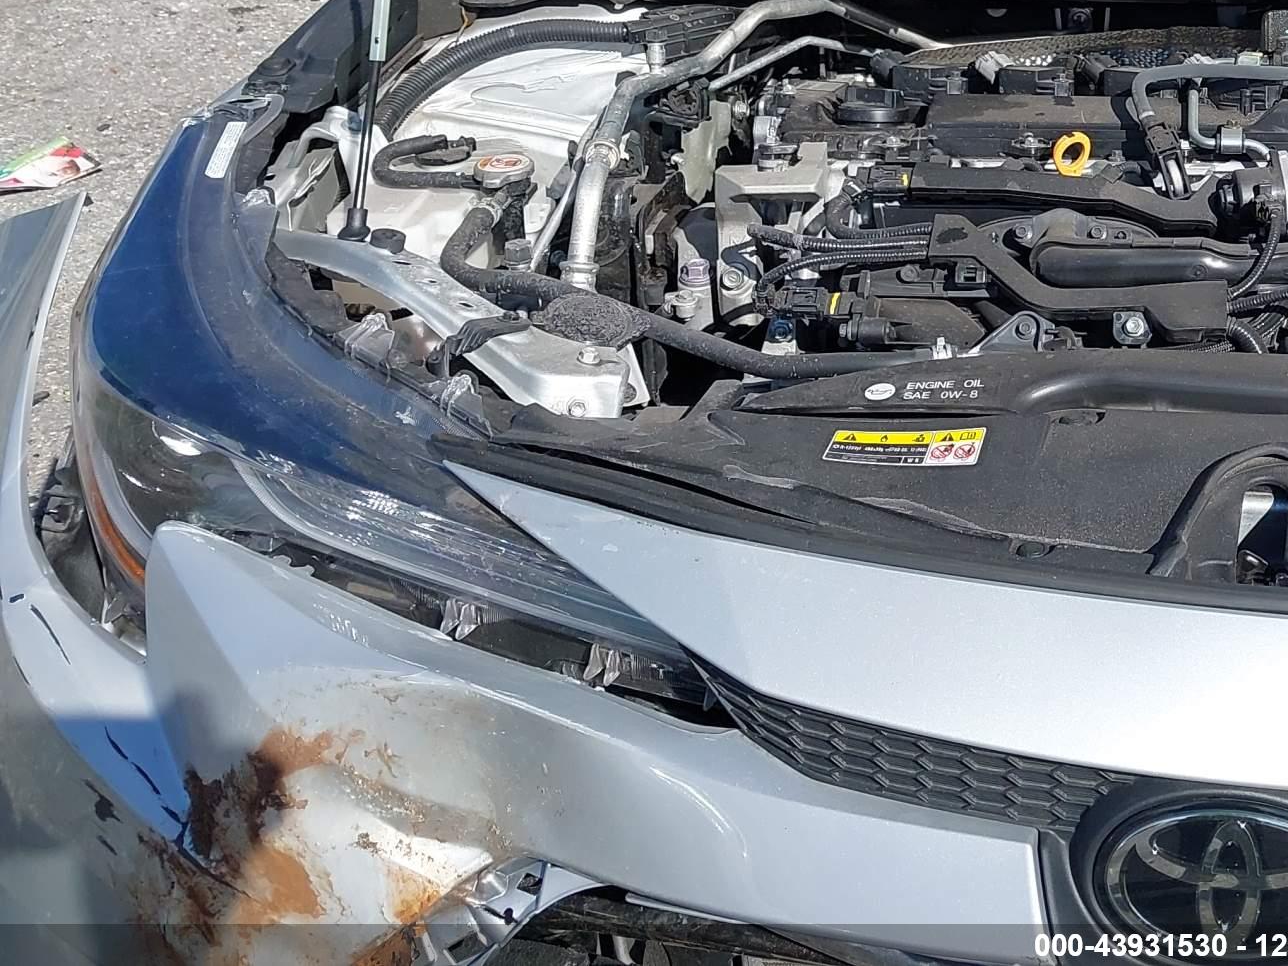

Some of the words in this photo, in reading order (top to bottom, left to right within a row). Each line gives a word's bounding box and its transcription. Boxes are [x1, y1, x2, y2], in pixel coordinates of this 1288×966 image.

[906, 380, 956, 390] ENGINE
[963, 379, 985, 388] OIL
[903, 391, 931, 400] SAE
[940, 390, 979, 399] 0W-8
